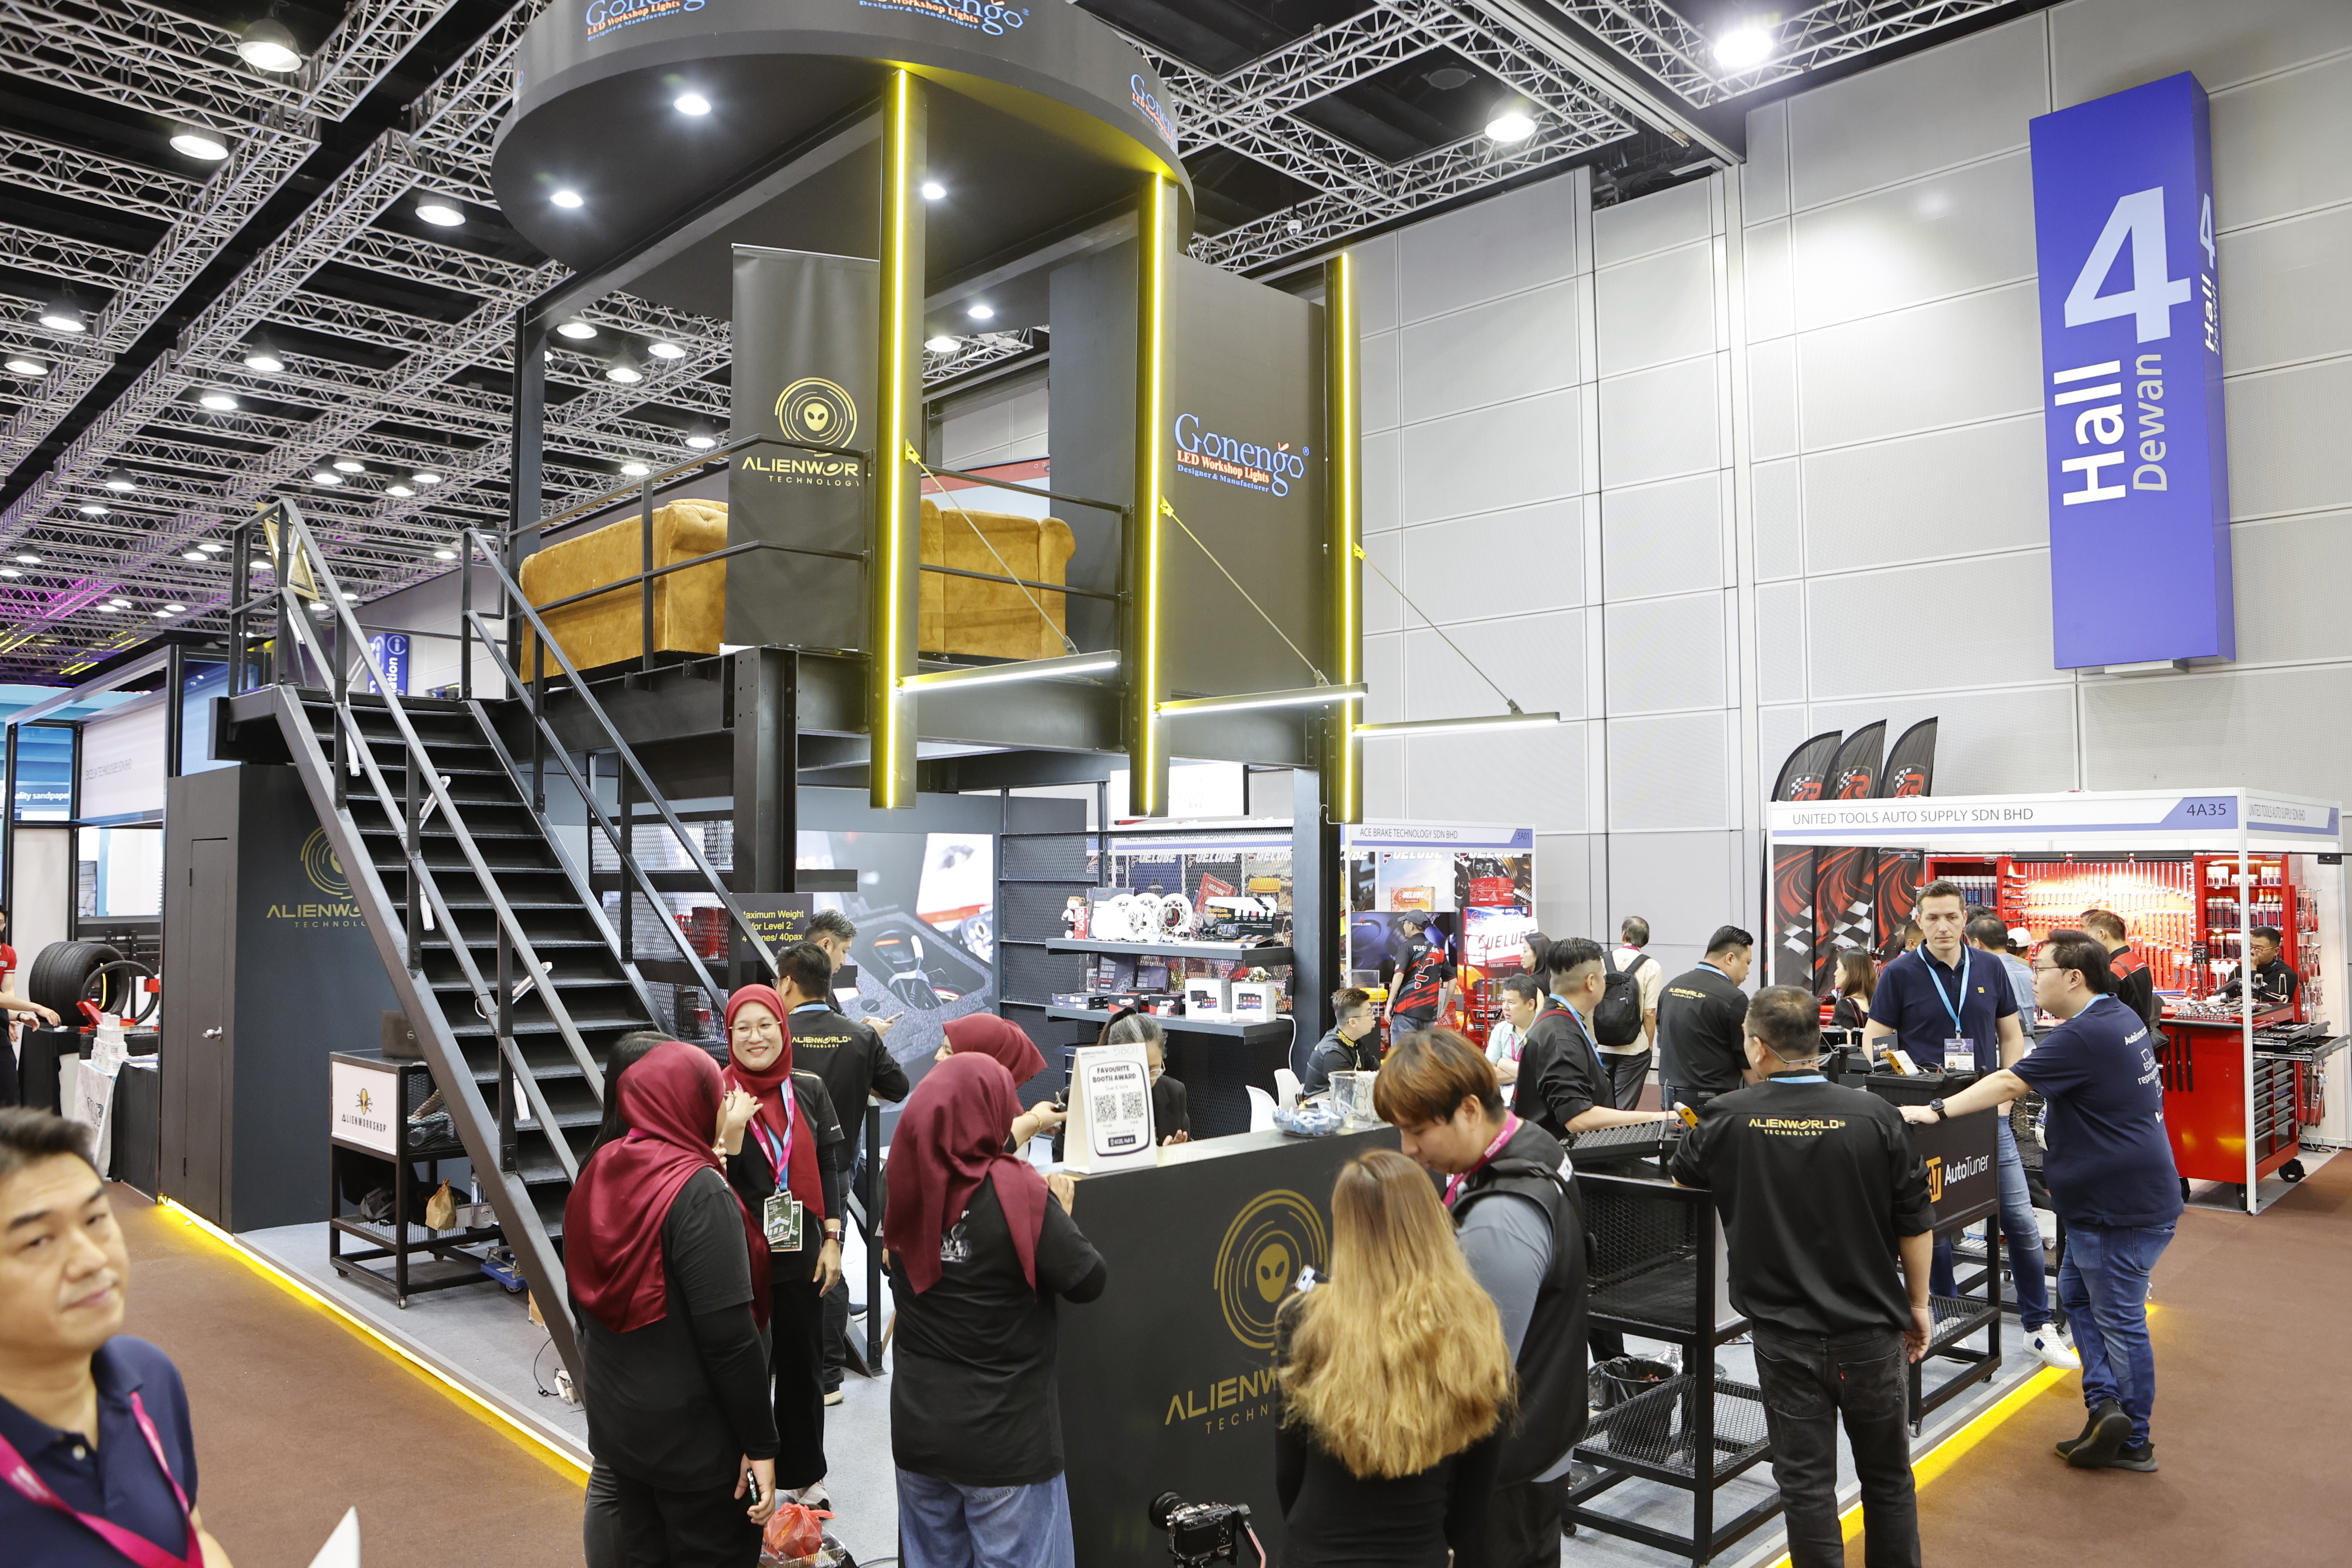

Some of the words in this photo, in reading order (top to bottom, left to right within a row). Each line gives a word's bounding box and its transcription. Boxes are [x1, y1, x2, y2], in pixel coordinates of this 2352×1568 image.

[587, 21, 606, 35] LED
[607, 7, 649, 26] Workshop
[651, 0, 681, 12] Lights
[624, 9, 680, 26] Manufacturer
[915, 7, 979, 30] Manufacturer
[948, 7, 979, 23] Lights
[2200, 193, 2215, 270] 4
[2064, 186, 2191, 344] 4
[2202, 273, 2215, 352] Hall
[2132, 355, 2168, 491] Dewan
[2054, 360, 2126, 506] Hall
[742, 457, 858, 476] ALIENWOR
[1177, 450, 1199, 466] LED
[1201, 456, 1243, 478] Workshop
[1245, 467, 1269, 483] Lights
[1177, 464, 1211, 478] Designer
[1220, 475, 1269, 492] Manufacturer
[15, 792, 32, 801] ality
[1170, 791, 1204, 802] APID
[1793, 814, 1836, 825] UNITED
[1838, 812, 1879, 824] TOOLS
[1882, 812, 1917, 823] AUTO
[1920, 810, 1968, 822] SUPPLY
[1972, 809, 2000, 821] SDN
[2004, 808, 2034, 820] BHD
[2187, 803, 2226, 816] 4A35
[2249, 803, 2261, 816] UNITED
[2261, 805, 2272, 817] TOOLS
[2272, 807, 2281, 818] AUTO
[2282, 807, 2292, 819] SUPPLY
[1373, 829, 1392, 837] BRAKE
[1394, 829, 1432, 838] TECHNOLOGY
[1433, 830, 1445, 838] SDN
[1447, 830, 1458, 839] BHD
[1518, 832, 1529, 840] 5A01
[778, 910, 804, 919] Weight
[764, 922, 784, 930] Level
[779, 933, 803, 942] 40pax
[1413, 945, 1439, 954] FUEBE
[1097, 1065, 1130, 1074] FAVOURITE
[342, 1114, 387, 1133] ALIENWORKSHOP
[1945, 1155, 1989, 1186] AutoTuner
